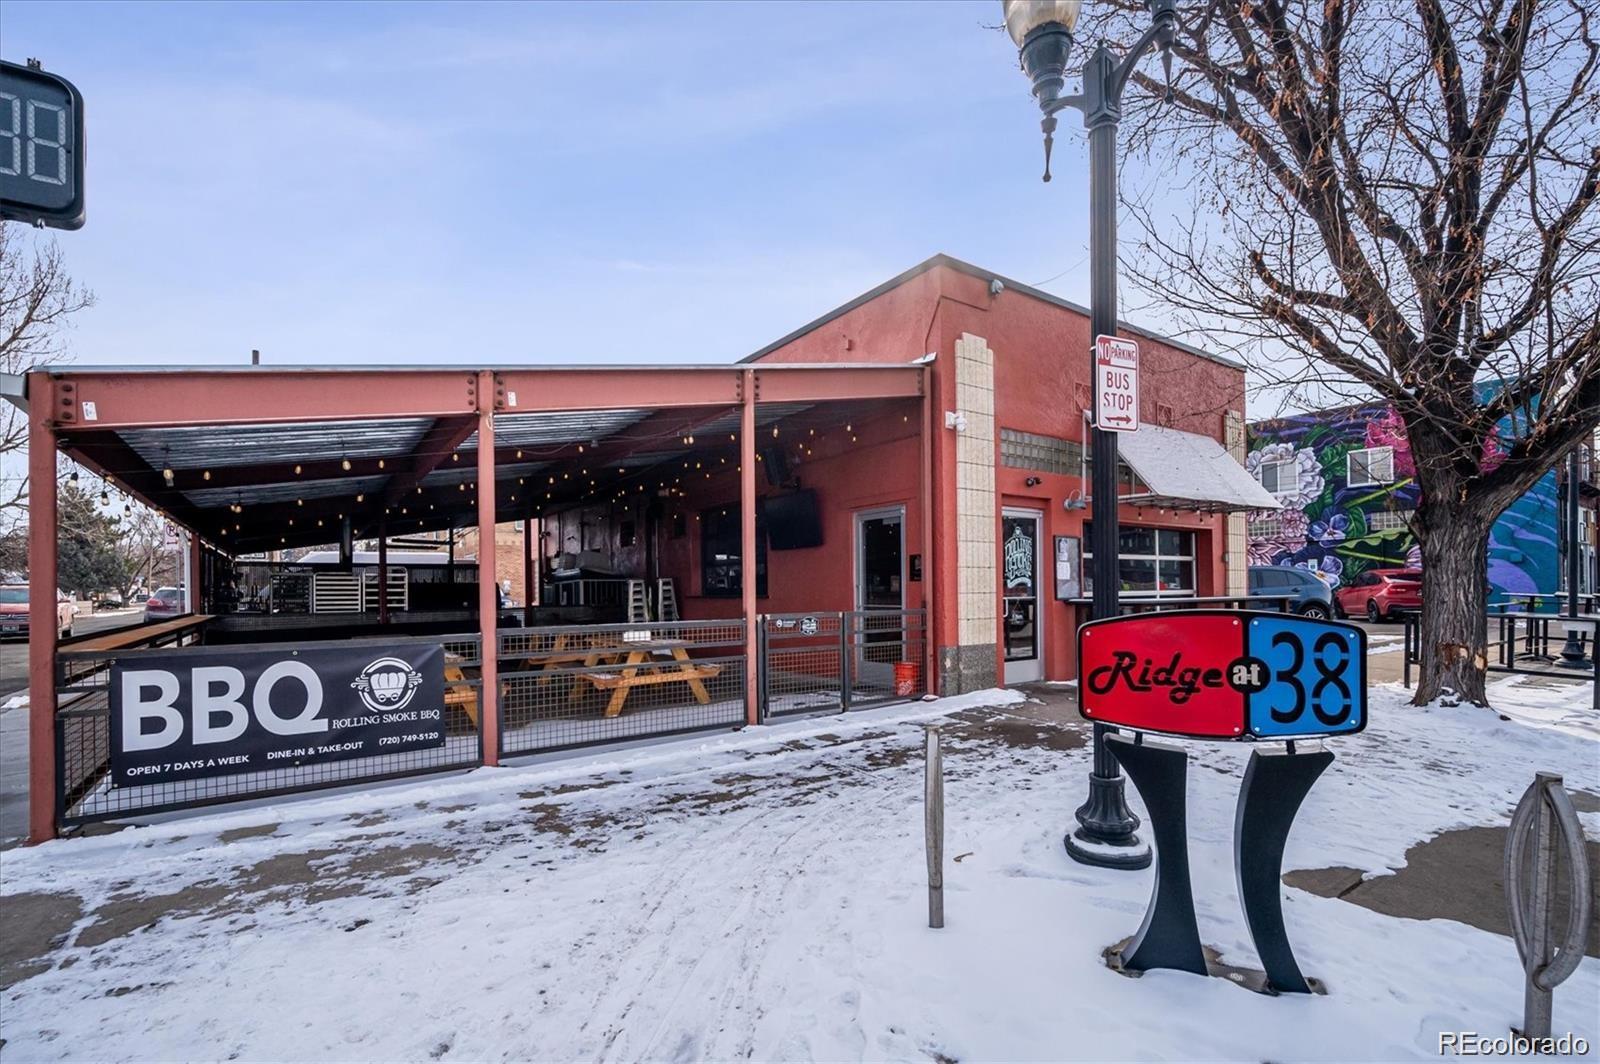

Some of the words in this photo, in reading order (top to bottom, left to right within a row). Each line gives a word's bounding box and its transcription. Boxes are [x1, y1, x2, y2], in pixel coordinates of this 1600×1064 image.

[1098, 342, 1110, 360] NO
[1111, 346, 1136, 362] PARKING
[1106, 371, 1130, 390] BUS
[1103, 392, 1133, 411] STOP
[1087, 651, 1225, 705] Ridge
[1232, 663, 1261, 686] at
[1270, 631, 1352, 726] 38
[121, 660, 329, 752] BBQ
[332, 714, 380, 729] ROLLING
[383, 711, 418, 724] SMOKE
[420, 709, 440, 721] BBQ
[378, 736, 400, 746] (720)
[402, 732, 438, 743] 749-5120
[267, 748, 306, 760] DINE-IN
[307, 747, 315, 755] &
[317, 741, 364, 754] TAKE-OUT
[127, 764, 161, 776] OPEN
[164, 763, 171, 772] 7
[174, 760, 204, 771] DAYS
[207, 758, 215, 767] A
[217, 755, 250, 766] WEEK
